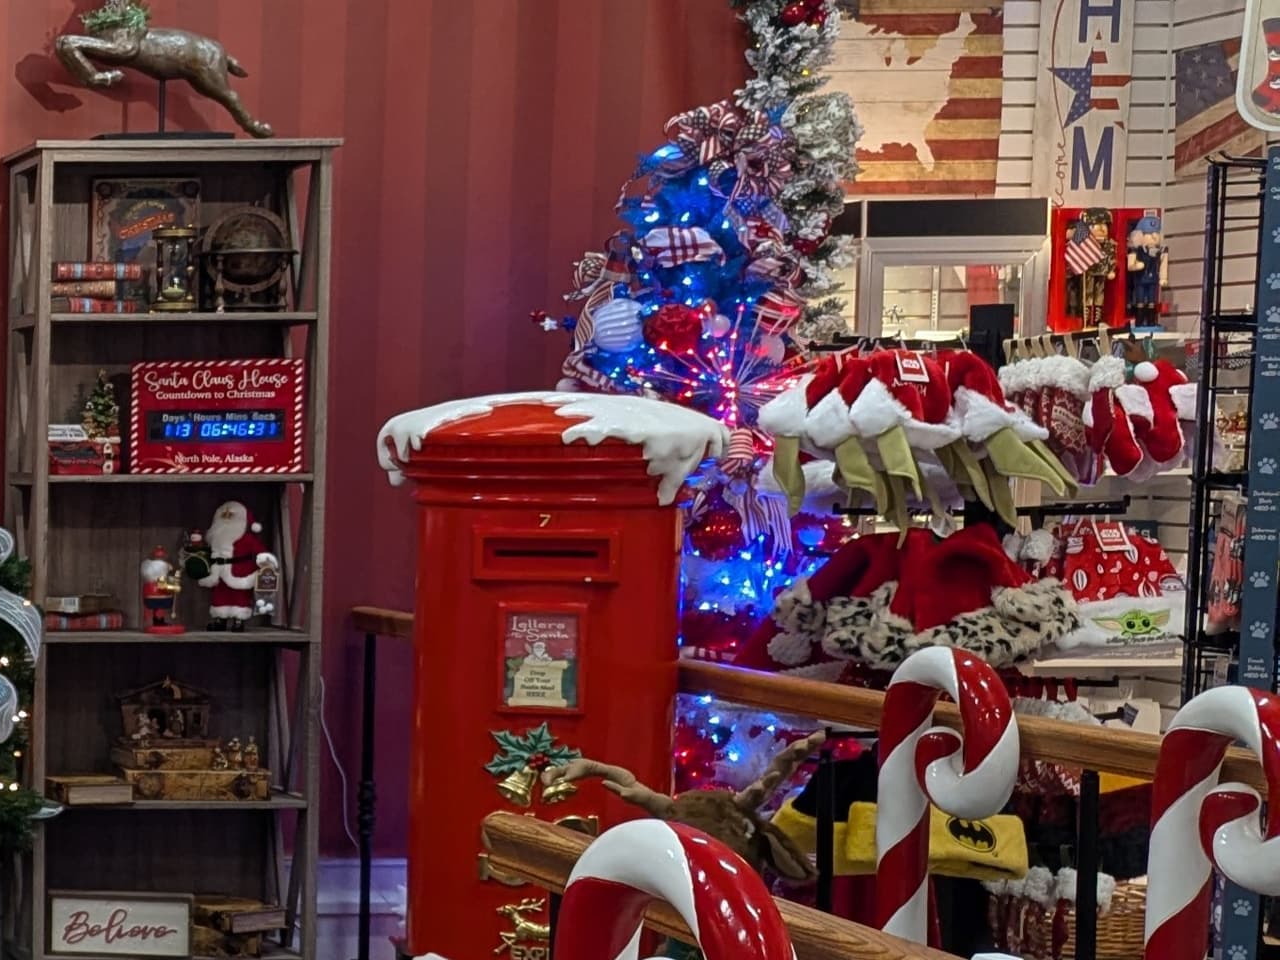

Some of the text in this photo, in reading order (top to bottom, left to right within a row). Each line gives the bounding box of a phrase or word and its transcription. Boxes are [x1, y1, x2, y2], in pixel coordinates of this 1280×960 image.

[144, 369, 288, 391] Santa Claus House
[156, 390, 275, 400] Countdown to Christmas
[162, 414, 185, 423] Days
[174, 454, 254, 463] North Pole, Alaska
[539, 513, 551, 527] 7
[512, 616, 566, 632] Letters
[526, 628, 569, 641] Santa
[62, 908, 178, 944] Believe
[510, 945, 549, 960] EXP
